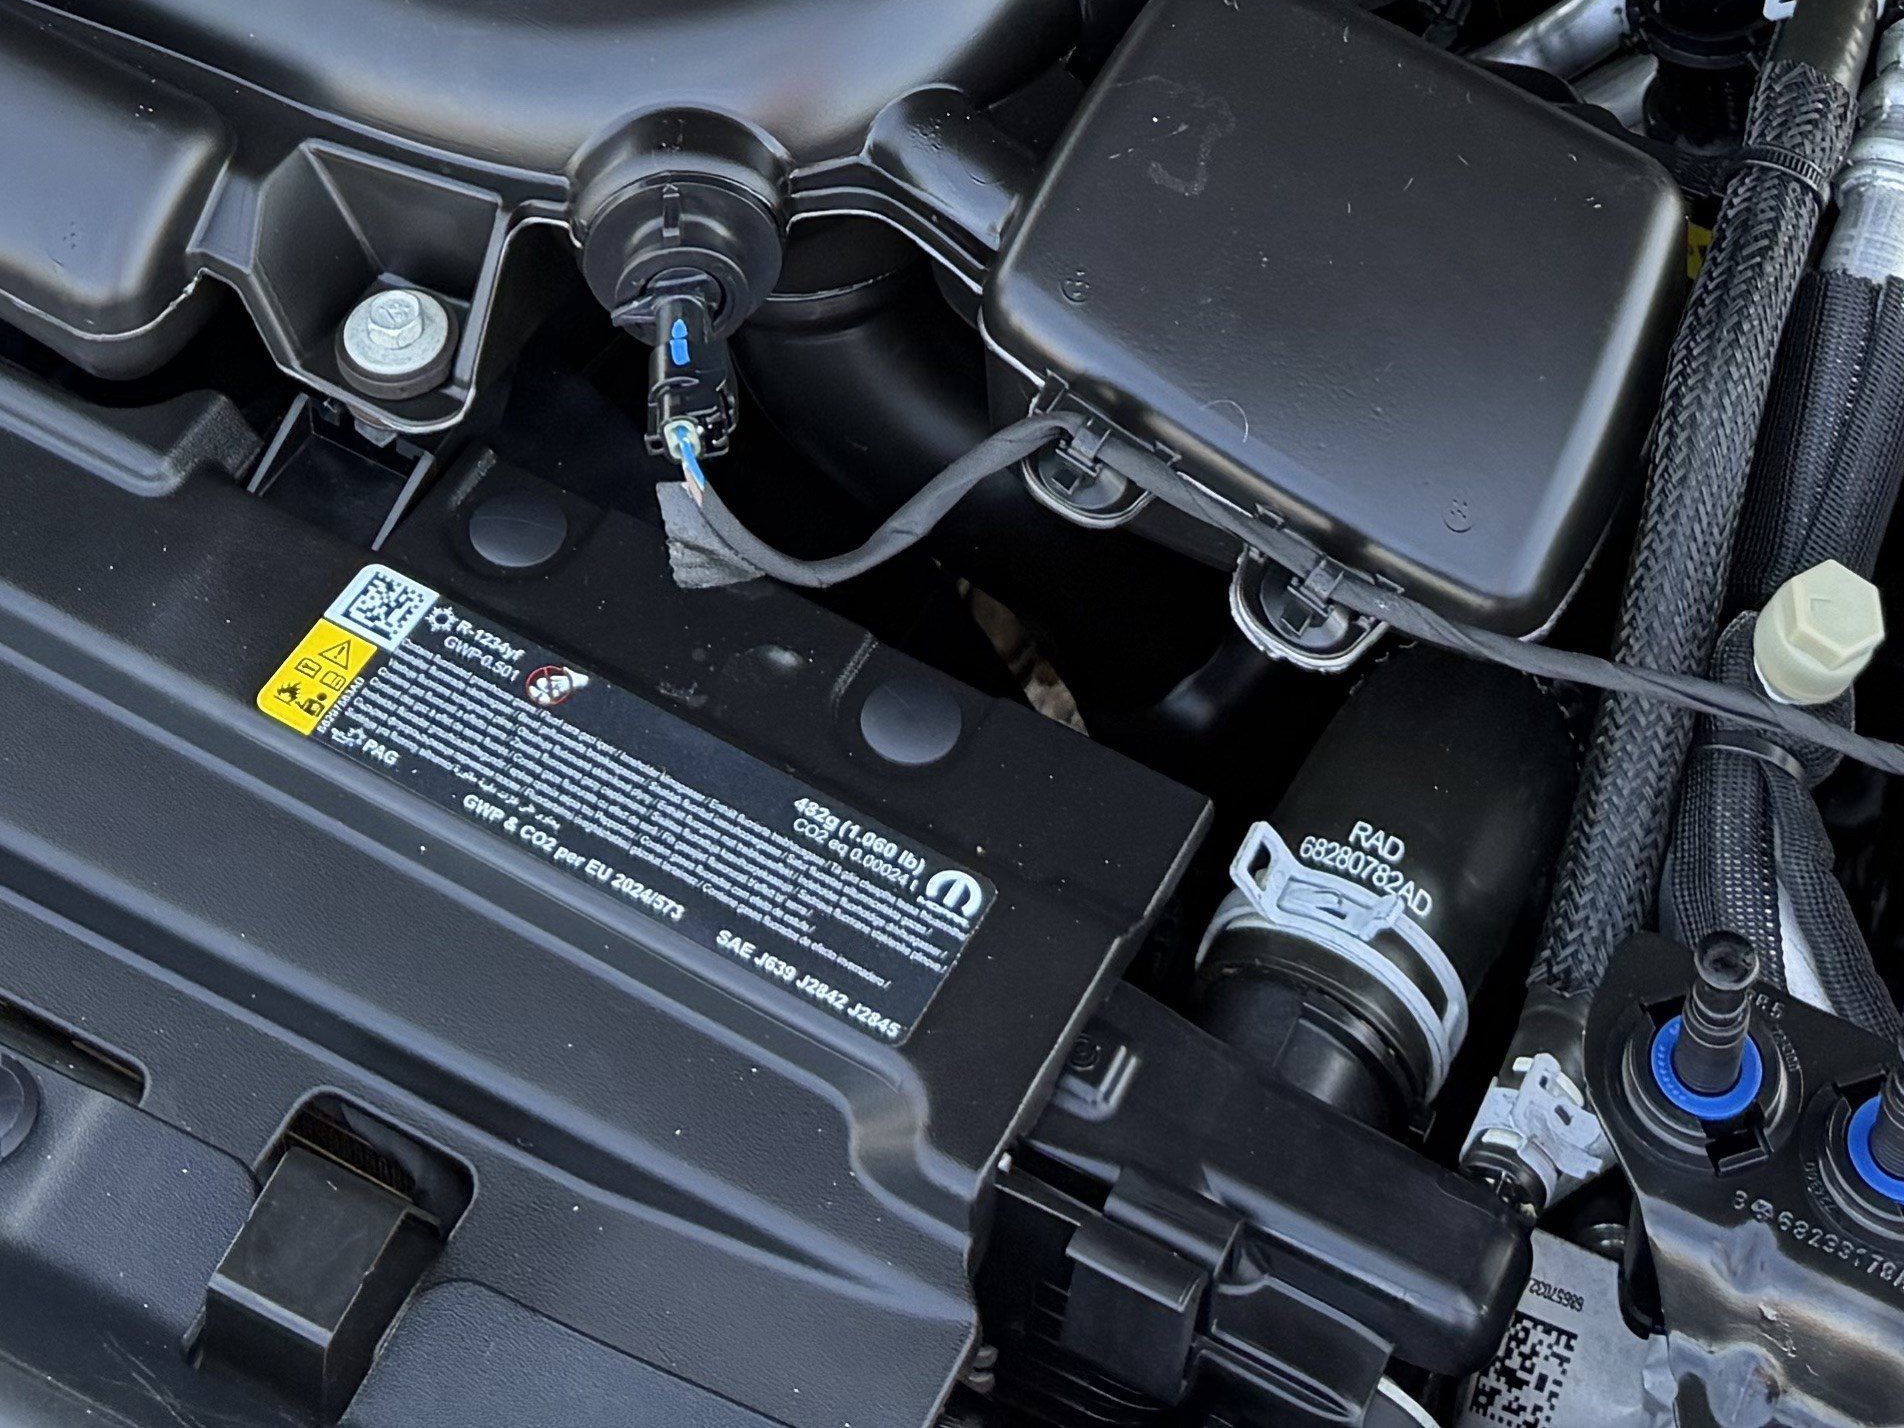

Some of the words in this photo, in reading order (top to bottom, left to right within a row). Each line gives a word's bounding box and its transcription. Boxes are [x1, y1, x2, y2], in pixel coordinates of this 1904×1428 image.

[453, 617, 525, 665] R-1234yf
[360, 736, 401, 768] PAG
[460, 792, 506, 826] GWP
[501, 814, 521, 834] &
[517, 822, 558, 853] CO2
[552, 843, 587, 871] per
[583, 858, 612, 883] EU
[608, 871, 686, 923] 2024/573
[789, 793, 842, 833] 482g
[835, 818, 900, 863] (1.060
[895, 848, 927, 877] lb)
[790, 815, 830, 846] CO2
[824, 836, 850, 859] eq
[847, 846, 911, 889] 0.00024
[1348, 821, 1405, 864] RAD
[1300, 836, 1433, 918] 68280782AD
[713, 928, 756, 960] SAE
[752, 948, 798, 982] J639
[794, 970, 850, 1011] J2842
[845, 998, 903, 1039] J2845
